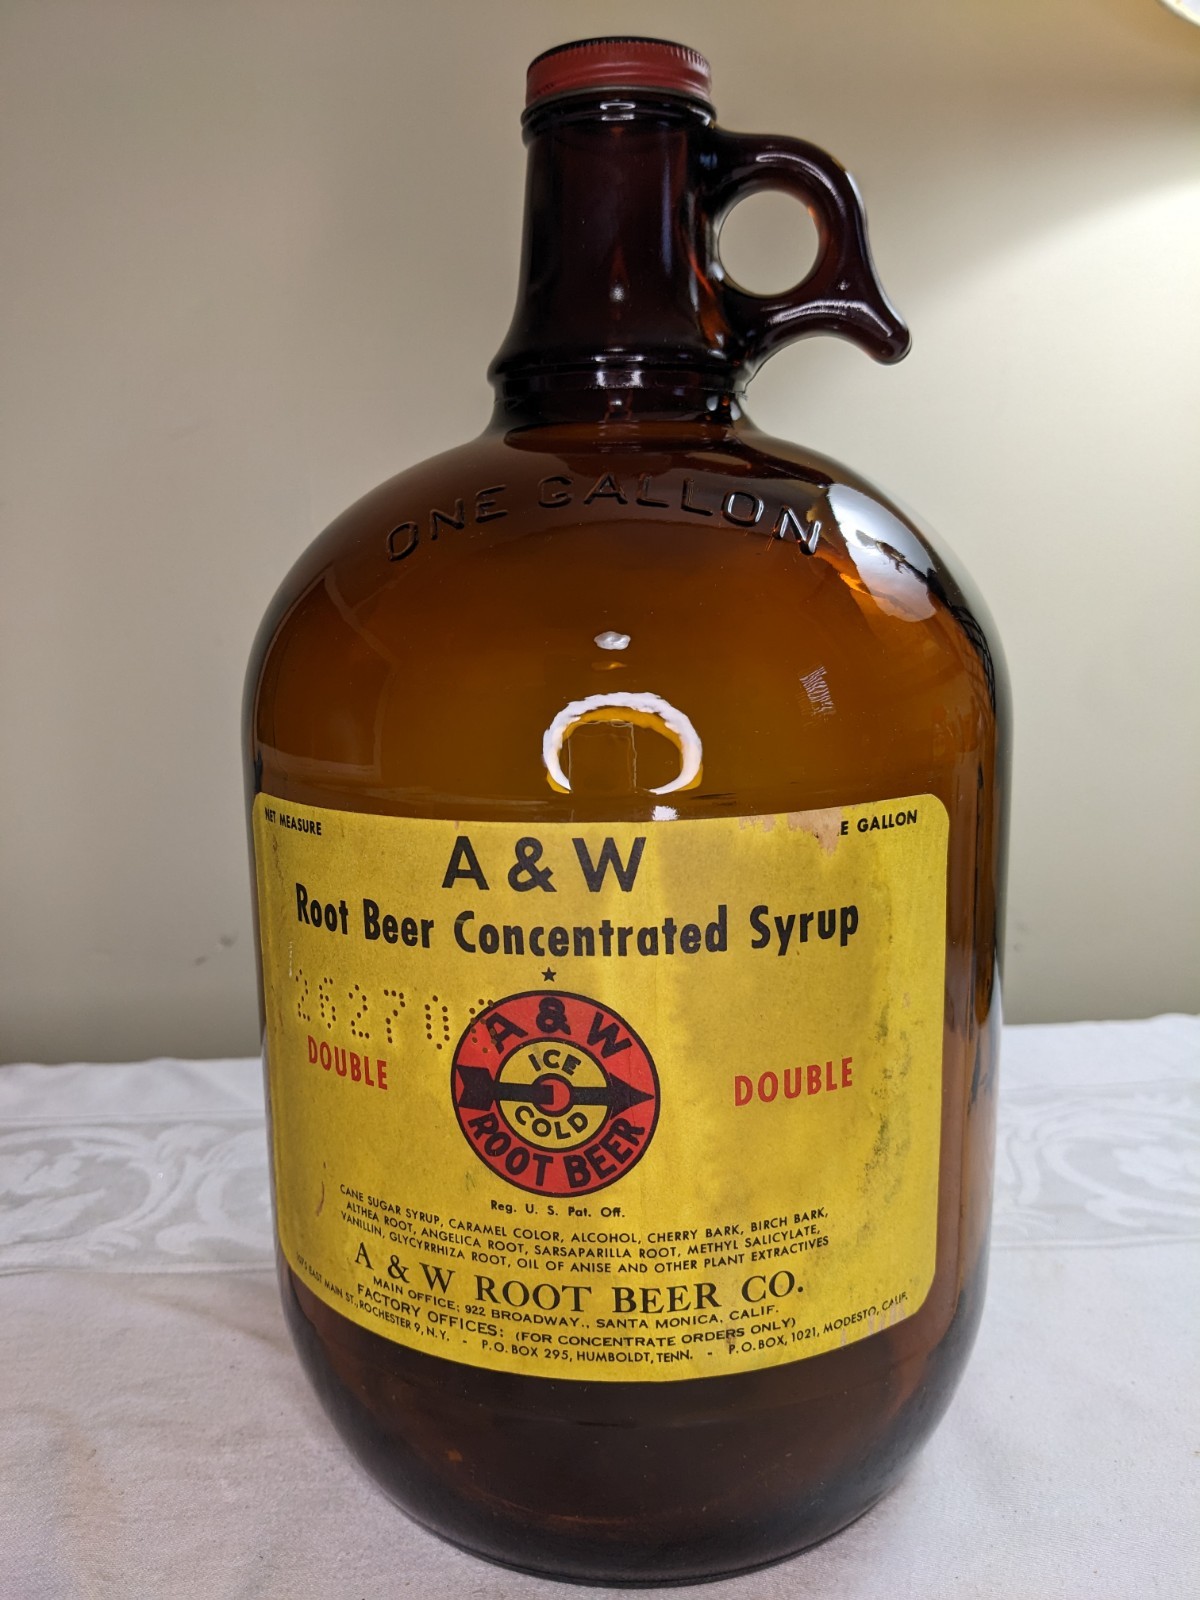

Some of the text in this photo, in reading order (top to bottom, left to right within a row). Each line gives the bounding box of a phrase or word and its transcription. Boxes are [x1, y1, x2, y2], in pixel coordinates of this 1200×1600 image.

[386, 473, 823, 561] ONE GALLON
[264, 806, 322, 836] NET MEASURE
[857, 809, 918, 833] GALLON
[441, 835, 647, 893] A & W
[295, 882, 859, 958] Root Beer Concentrated Syrup
[482, 996, 634, 1059] A & W
[307, 1034, 388, 1090] DOUBLE
[528, 1048, 583, 1077] ICE
[734, 1056, 853, 1107] DOUBLE
[467, 1111, 646, 1189] ROOT BEER
[514, 1105, 590, 1141] COLD
[340, 1183, 829, 1245] CANE SUGAR SYRUP, CARAMEL COLOR, ALCOHOL, CHERRY BARK, BIRCH BARK,
[346, 1201, 821, 1259] ALTHEA ROOT, ANGELICA ROOT, SARSAPARILLA ROOT, METHYL SALICYLATE,
[490, 1199, 626, 1218] Reg. U. S. Pat. Off.
[340, 1210, 830, 1274] VANILLIN, GLYCYRRHIZA ROOT, OIL OF ANISE AND OTHER PLANT EXTRACTIVES
[354, 1241, 804, 1315] A & W ROOT BEER CO.
[373, 1275, 404, 1296] MAIN
[464, 1304, 487, 1317] 922
[596, 1318, 650, 1329] SANTA
[729, 1304, 780, 1321] CALIF.
[309, 1265, 322, 1284] EAST
[324, 1278, 344, 1299] MAIN
[359, 1299, 411, 1330] ROCHESTER
[414, 1322, 424, 1336] 9,
[426, 1325, 451, 1342] N.Y.
[511, 1344, 539, 1357] BOX
[544, 1349, 573, 1363] 295,
[576, 1351, 654, 1364] HUMBOLDT,
[656, 1350, 693, 1363] TENN.
[758, 1334, 788, 1350] BOX,
[791, 1326, 820, 1343] 1021,
[822, 1305, 880, 1334] MODESTO,
[881, 1291, 908, 1311] CALIF.
[357, 1282, 422, 1318] FACTORY
[515, 1331, 553, 1344] (FOR
[557, 1335, 677, 1347] CONCENTRATE
[681, 1327, 745, 1345] ORDERS
[750, 1317, 796, 1335] ONLY)
